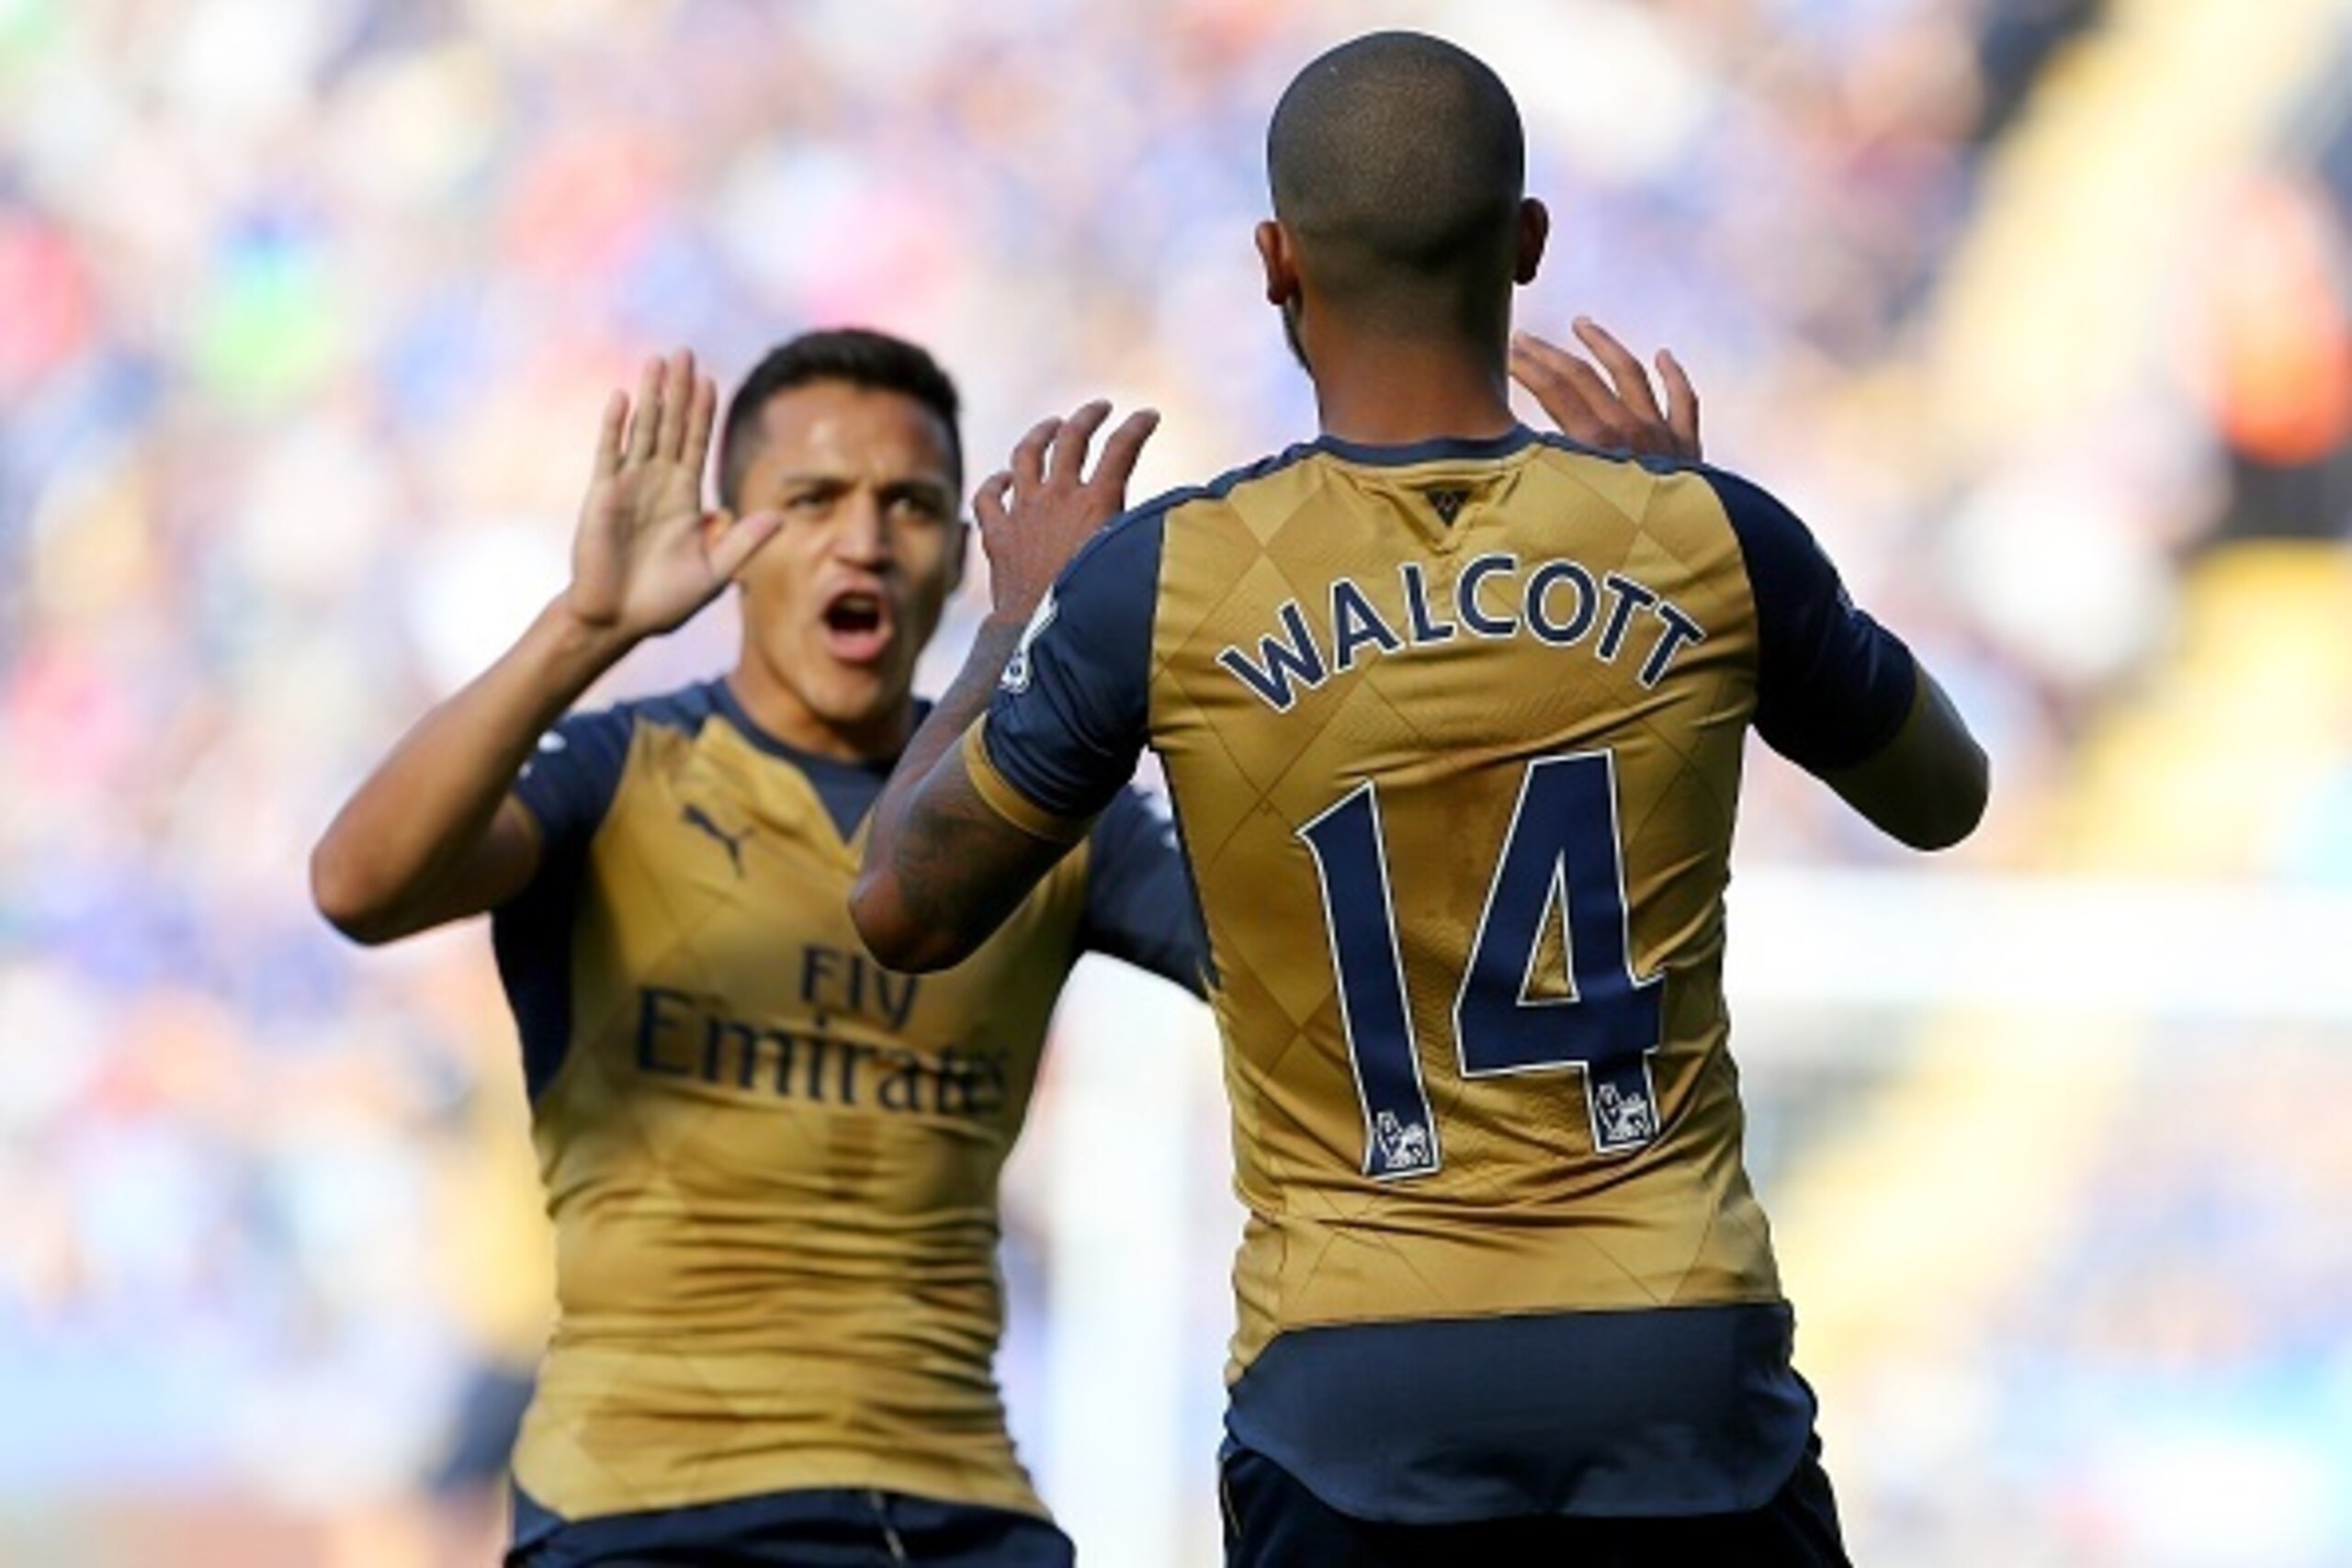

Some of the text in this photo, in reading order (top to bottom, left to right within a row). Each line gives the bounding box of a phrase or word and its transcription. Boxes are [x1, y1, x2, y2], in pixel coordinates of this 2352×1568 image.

[1216, 553, 1706, 714] WALCOTT
[801, 943, 920, 1032] Fly
[1296, 748, 1666, 1182] 14
